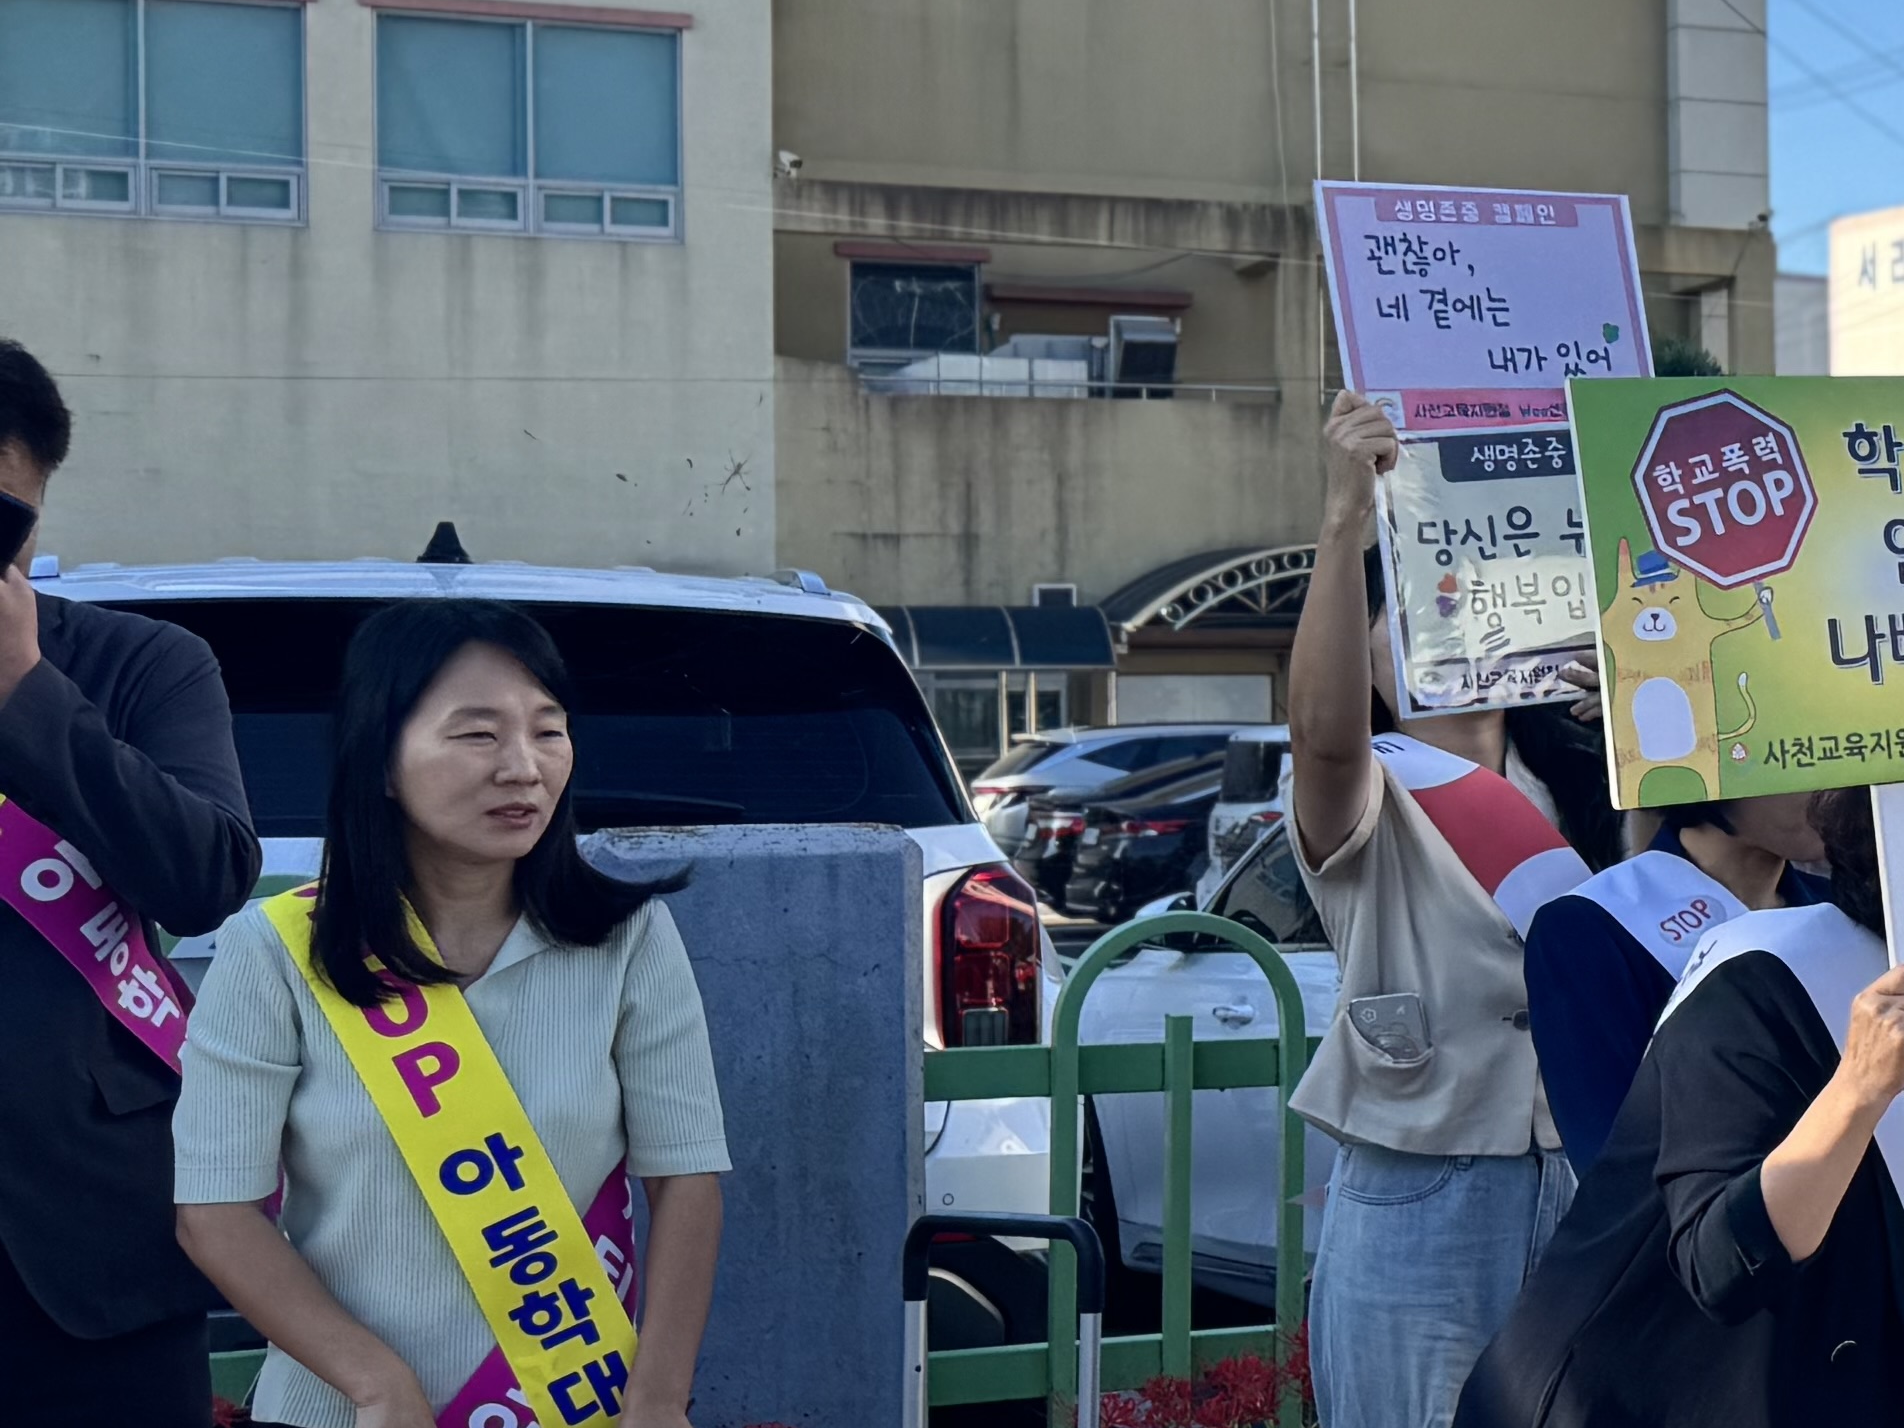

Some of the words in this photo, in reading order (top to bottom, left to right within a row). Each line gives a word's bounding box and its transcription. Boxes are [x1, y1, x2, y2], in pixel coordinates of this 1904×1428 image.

[1376, 294, 1409, 322] 네
[1420, 287, 1510, 329] 곁에는
[1488, 345, 1548, 374] 내가
[1556, 340, 1613, 377] 있어
[1470, 435, 1566, 472] 생명존중
[1652, 432, 1786, 497] 학교폭력
[1667, 469, 1795, 548] STOP
[1417, 505, 1541, 567] 당신은
[1660, 898, 1714, 942] STOP
